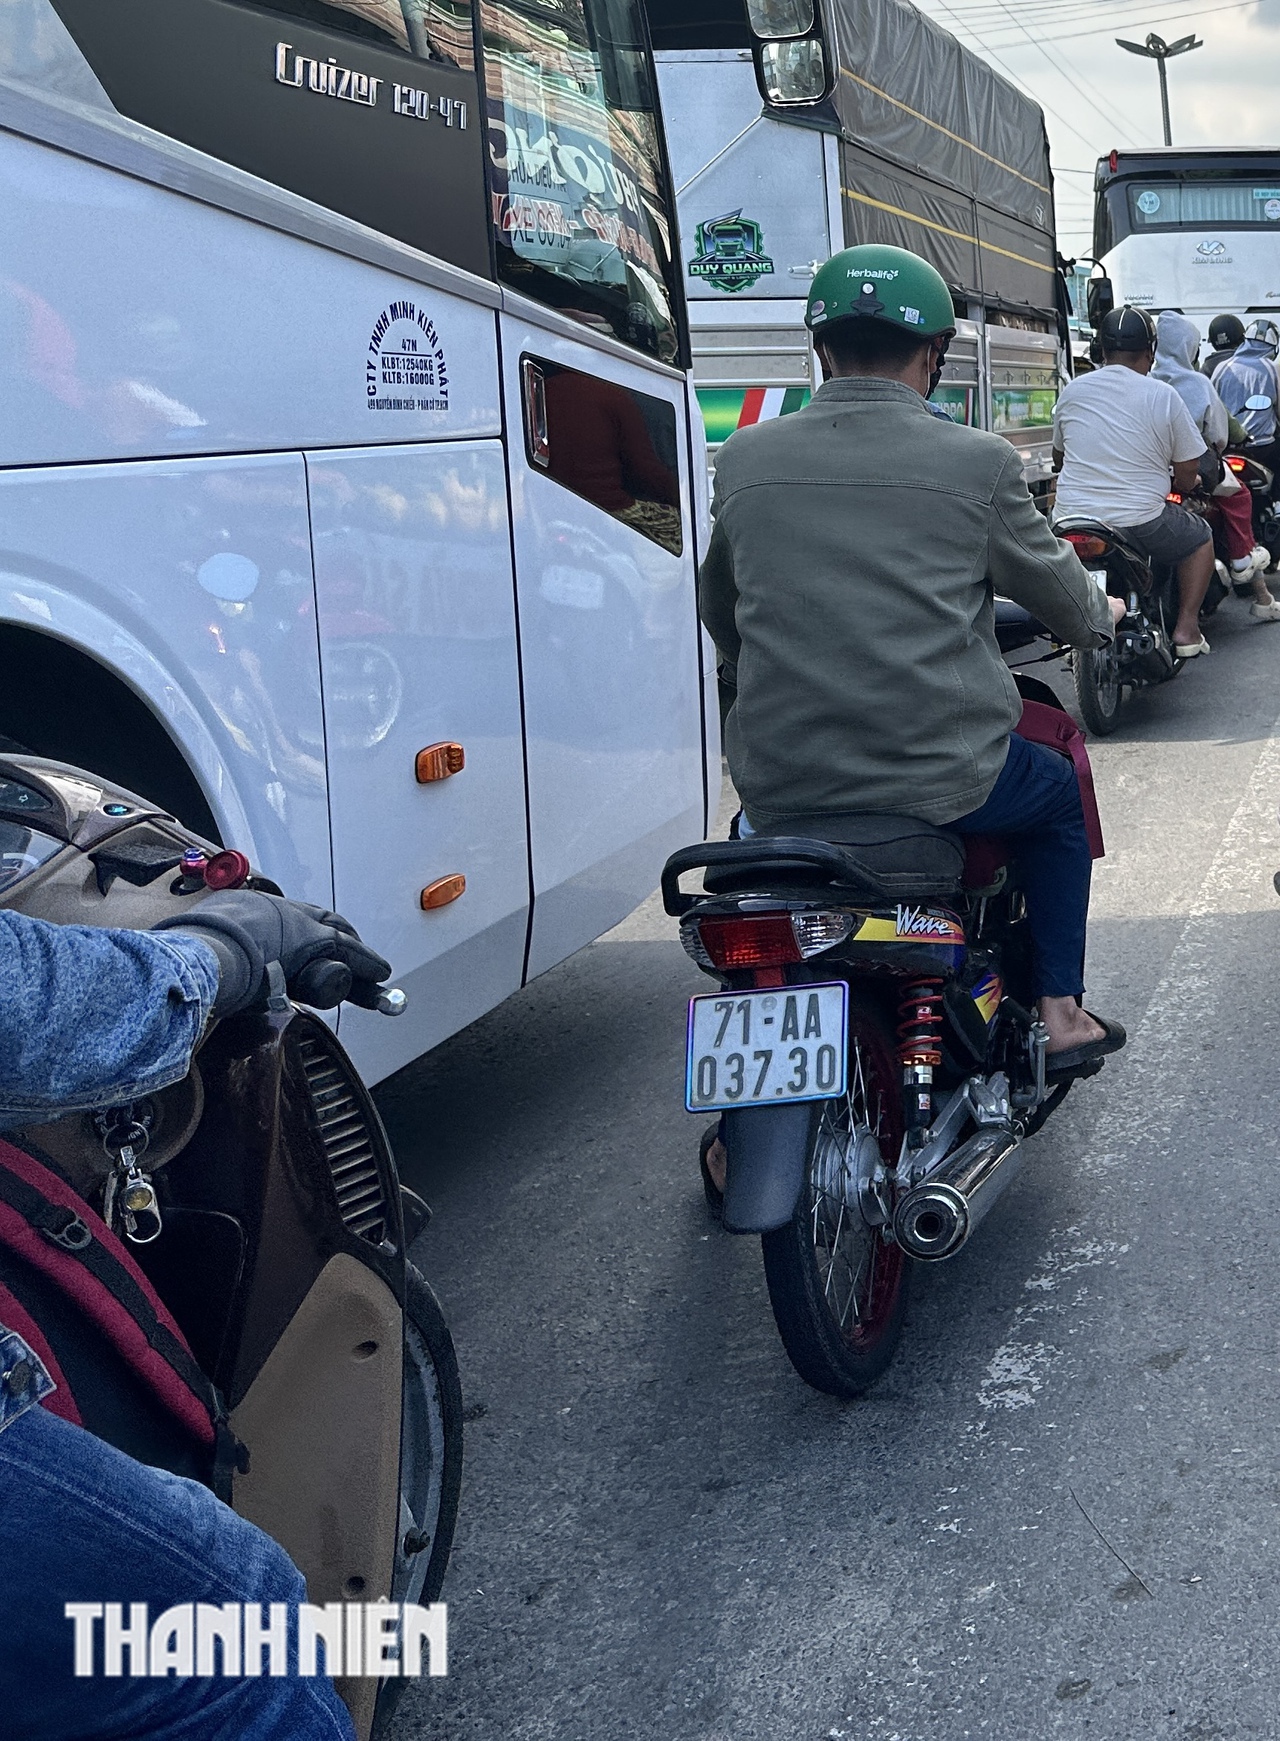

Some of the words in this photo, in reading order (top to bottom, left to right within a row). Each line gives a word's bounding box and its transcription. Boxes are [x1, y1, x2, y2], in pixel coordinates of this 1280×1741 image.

[276, 42, 384, 107] Cruizer
[392, 83, 467, 130] 120-47
[690, 263, 720, 275] DUY
[722, 262, 773, 275] QUANG
[846, 268, 893, 281] Herbalife
[389, 300, 415, 322] MINH
[416, 309, 439, 348] KIÊN
[368, 310, 390, 356] TNHH
[401, 338, 418, 352] 47N
[366, 359, 377, 397] CTY
[381, 356, 433, 372] KLBT:12540KG
[434, 348, 450, 399] PHÁT
[896, 903, 955, 936] Wave
[713, 993, 822, 1049] 71-AA
[697, 1044, 836, 1100] 037.30
